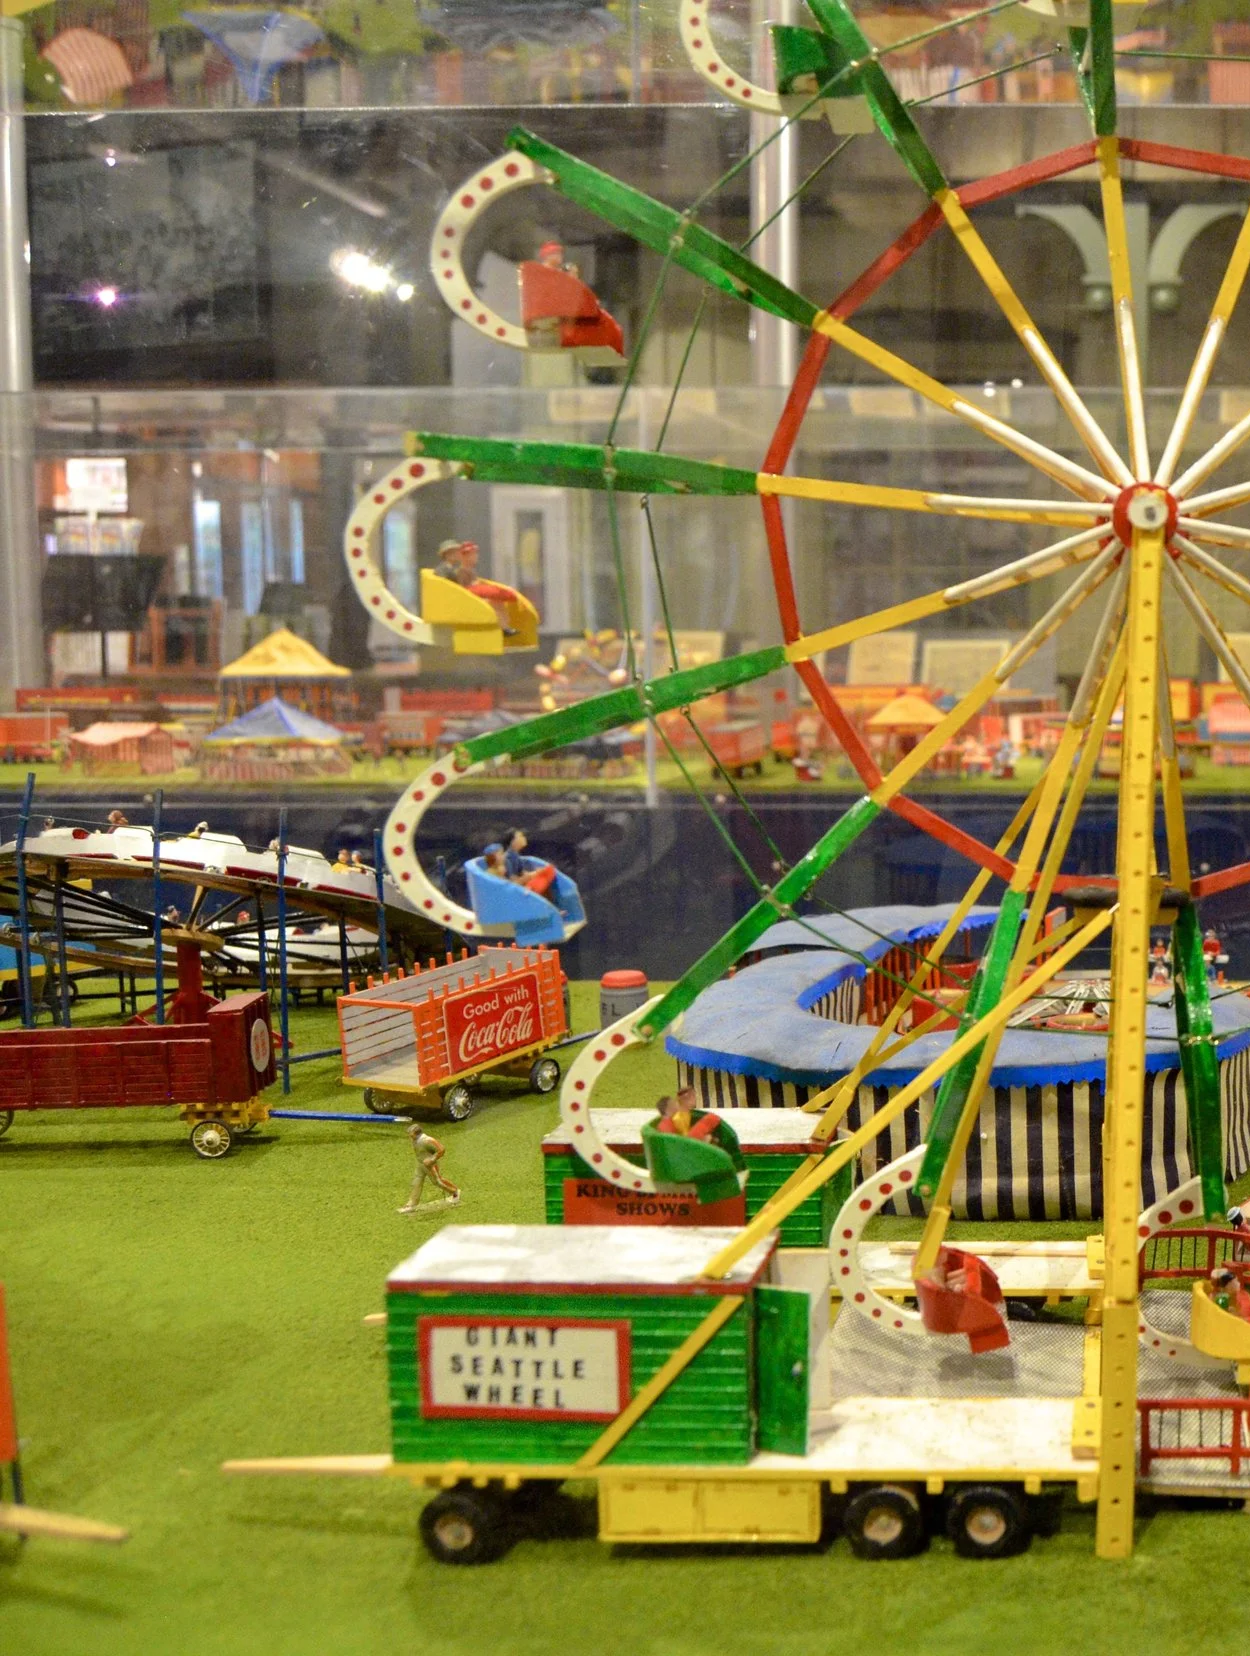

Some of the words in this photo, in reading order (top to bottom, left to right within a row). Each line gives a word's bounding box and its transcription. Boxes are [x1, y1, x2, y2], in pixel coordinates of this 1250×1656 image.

[463, 993, 500, 1019] Good
[504, 984, 529, 1004] with
[616, 1202, 690, 1216] SHOWS
[465, 1326, 559, 1347] GIANT
[450, 1355, 585, 1379] SEATTLE
[463, 1384, 566, 1409] WHEEL
